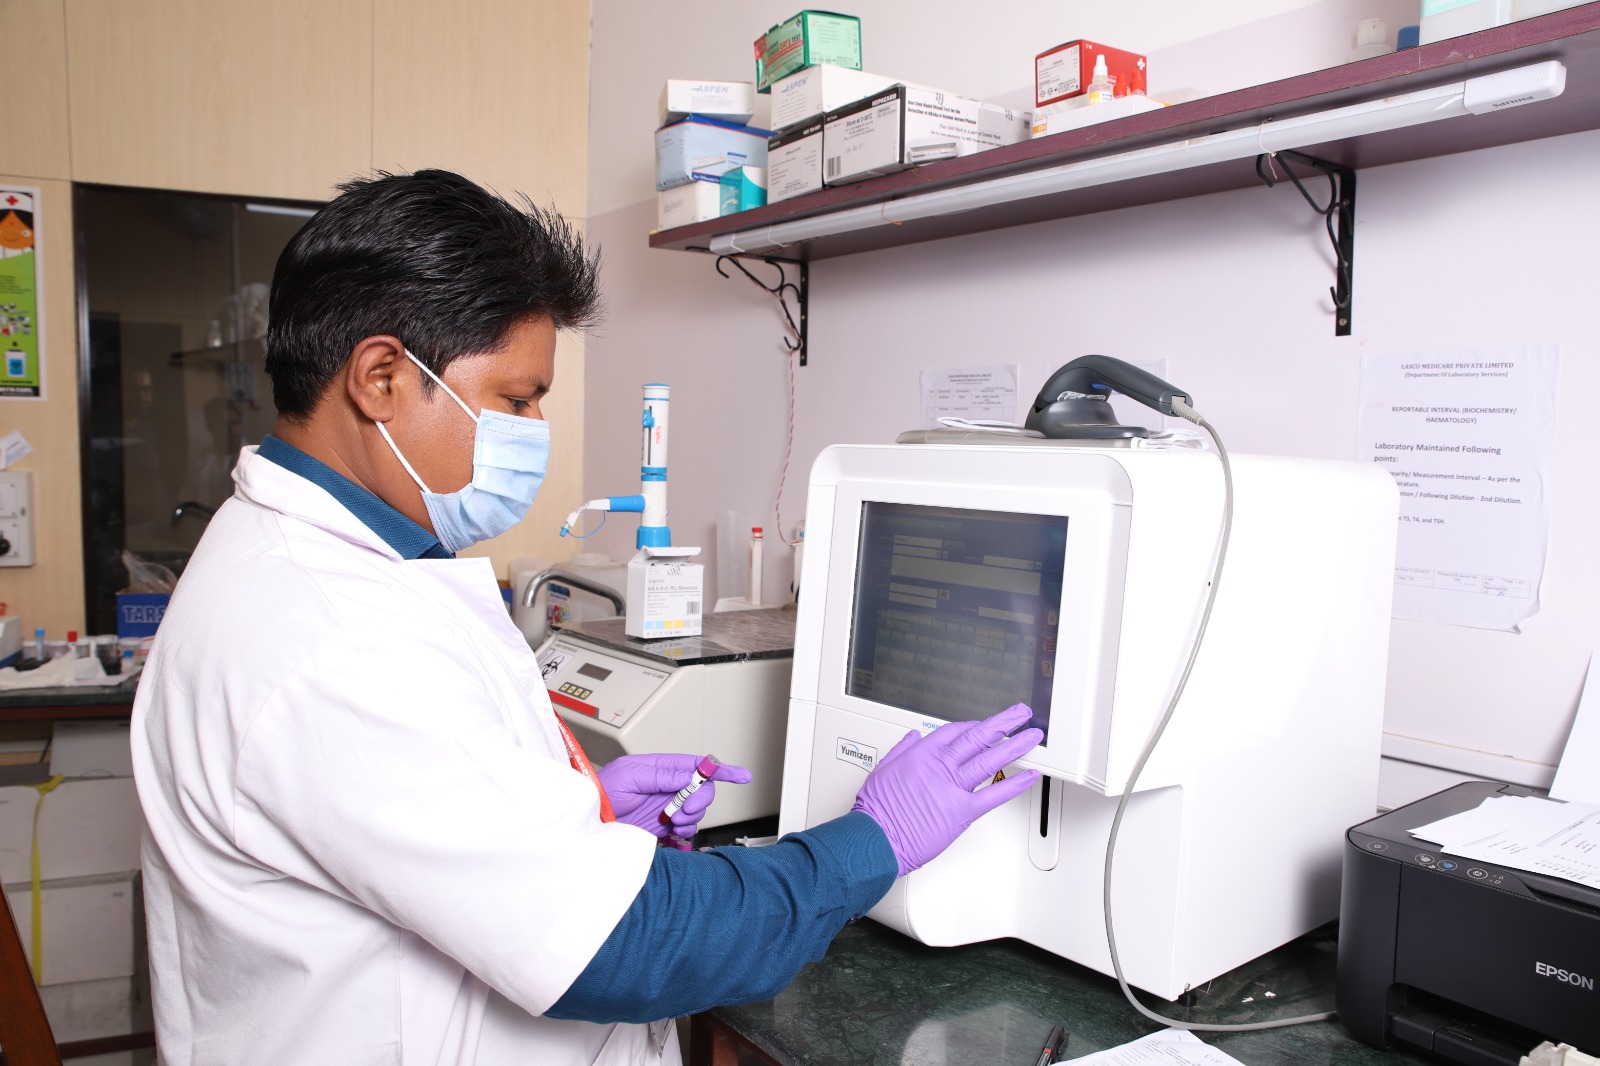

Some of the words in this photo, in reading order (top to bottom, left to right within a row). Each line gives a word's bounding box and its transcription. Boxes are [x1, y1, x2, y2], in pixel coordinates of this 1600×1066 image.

[698, 86, 728, 94] ASPEN
[785, 78, 807, 92] ASPEN
[1492, 96, 1534, 108] PHILIPS
[1375, 442, 1414, 452] Laboratory
[1416, 444, 1460, 452] Maintained
[1462, 446, 1501, 455] Following
[1374, 455, 1398, 464] points:
[1413, 472, 1454, 480] Measurement
[1420, 492, 1448, 500] Following
[922, 721, 941, 730] HORI
[840, 745, 873, 762] Yumizen
[1536, 961, 1594, 991] EPSON
